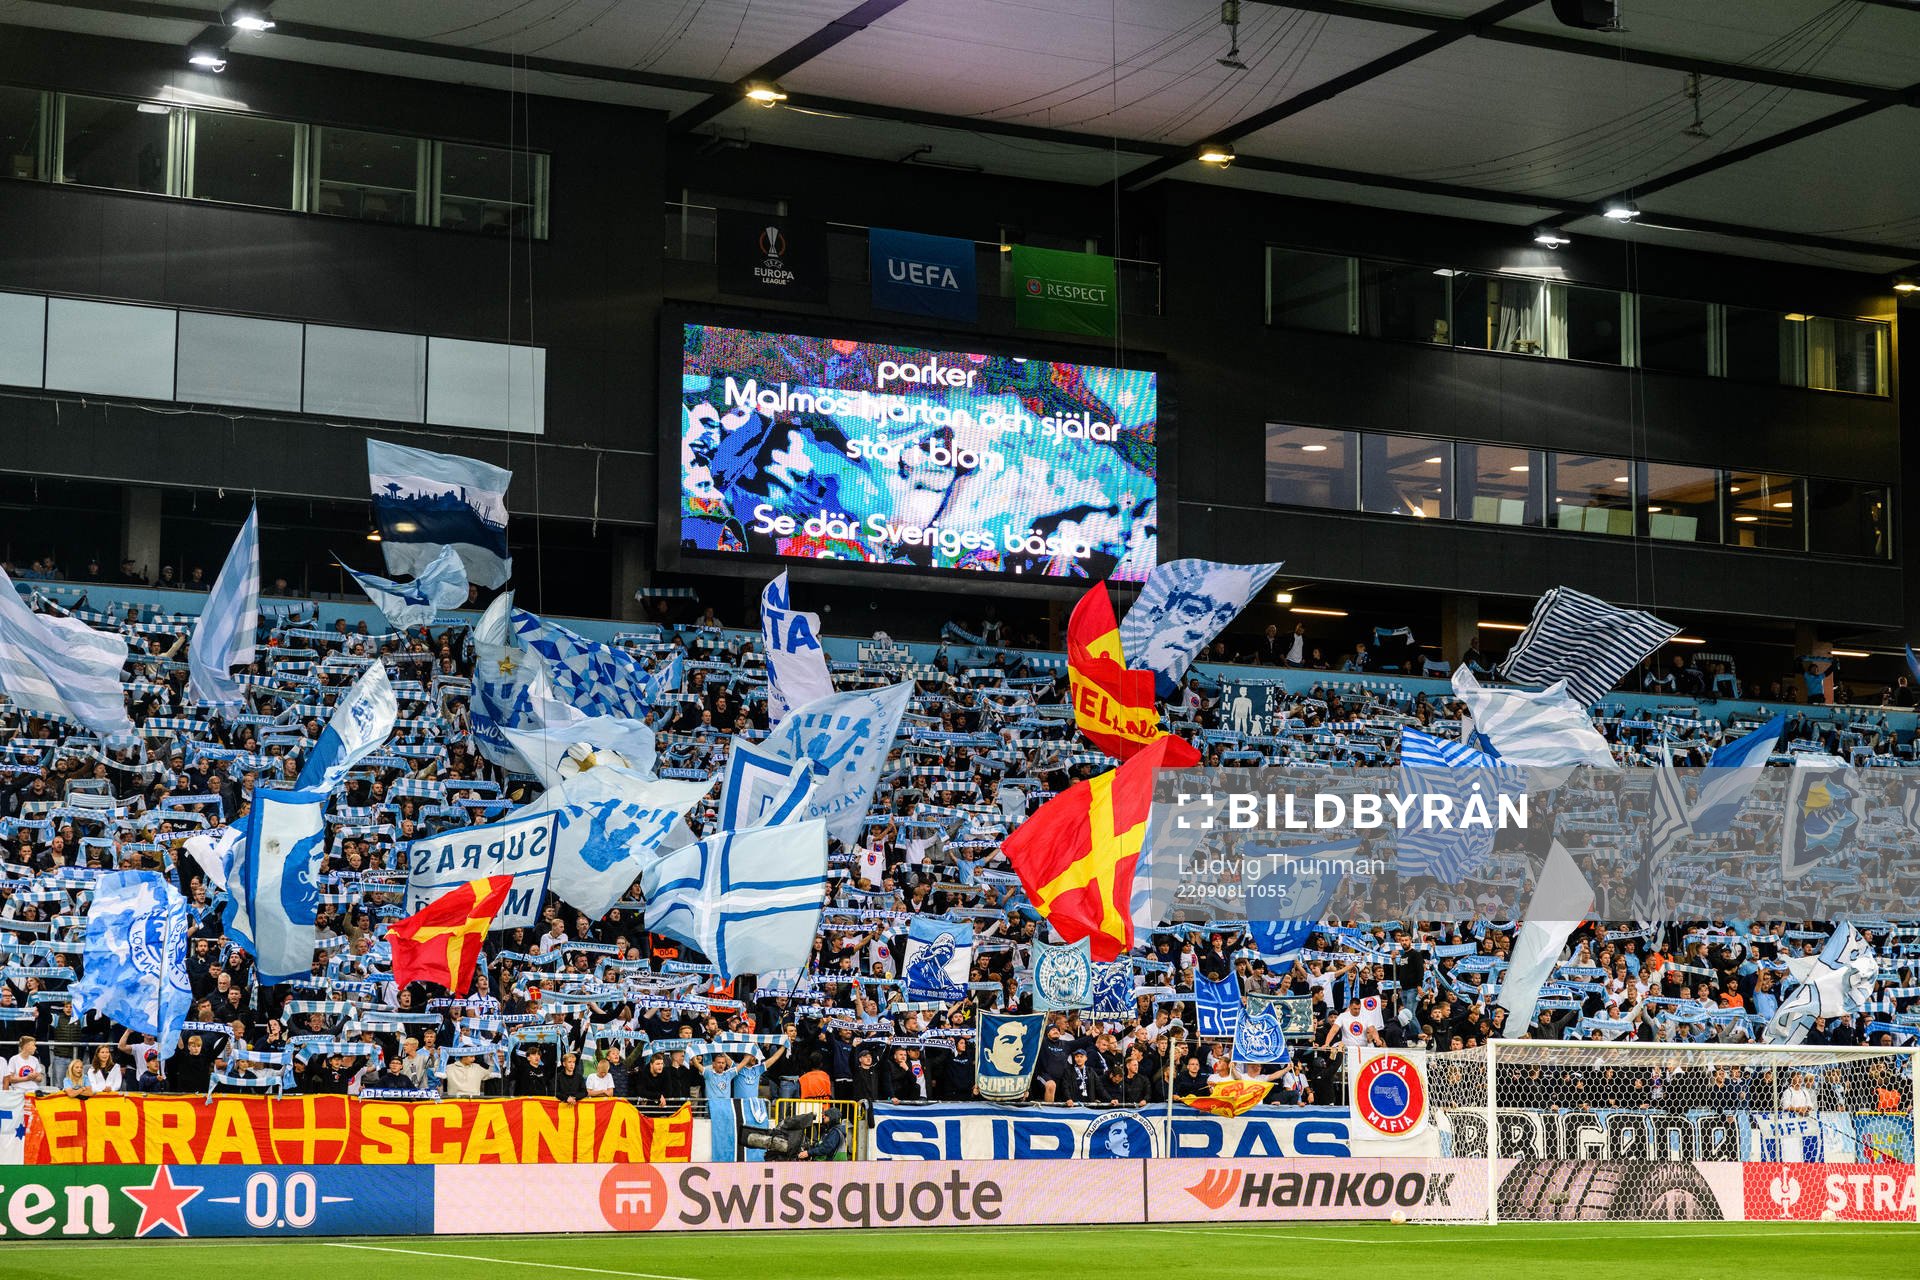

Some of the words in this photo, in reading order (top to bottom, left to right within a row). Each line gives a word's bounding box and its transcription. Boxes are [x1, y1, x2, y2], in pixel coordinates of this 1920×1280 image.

[754, 267, 795, 280] EUROPA
[764, 258, 784, 268] UEFA
[888, 258, 960, 289] UEFA
[762, 277, 787, 285] LEAGUE
[1047, 283, 1107, 302] RESPECT
[877, 356, 977, 388] parker
[725, 376, 851, 416] Malmös
[979, 405, 1032, 434] och
[1041, 411, 1122, 446] själar
[929, 437, 1004, 471] blom
[753, 504, 795, 535] Se
[804, 510, 860, 540] där
[867, 513, 996, 556] Sveriges
[1004, 524, 1091, 559] bästa
[1370, 1058, 1407, 1077] UEFA
[360, 1100, 692, 1164] SCANIAE
[1367, 1111, 1414, 1132] MAFIA
[0, 1182, 115, 1235] en
[244, 1171, 318, 1229] 0.0
[678, 1166, 1003, 1228] Swissquote
